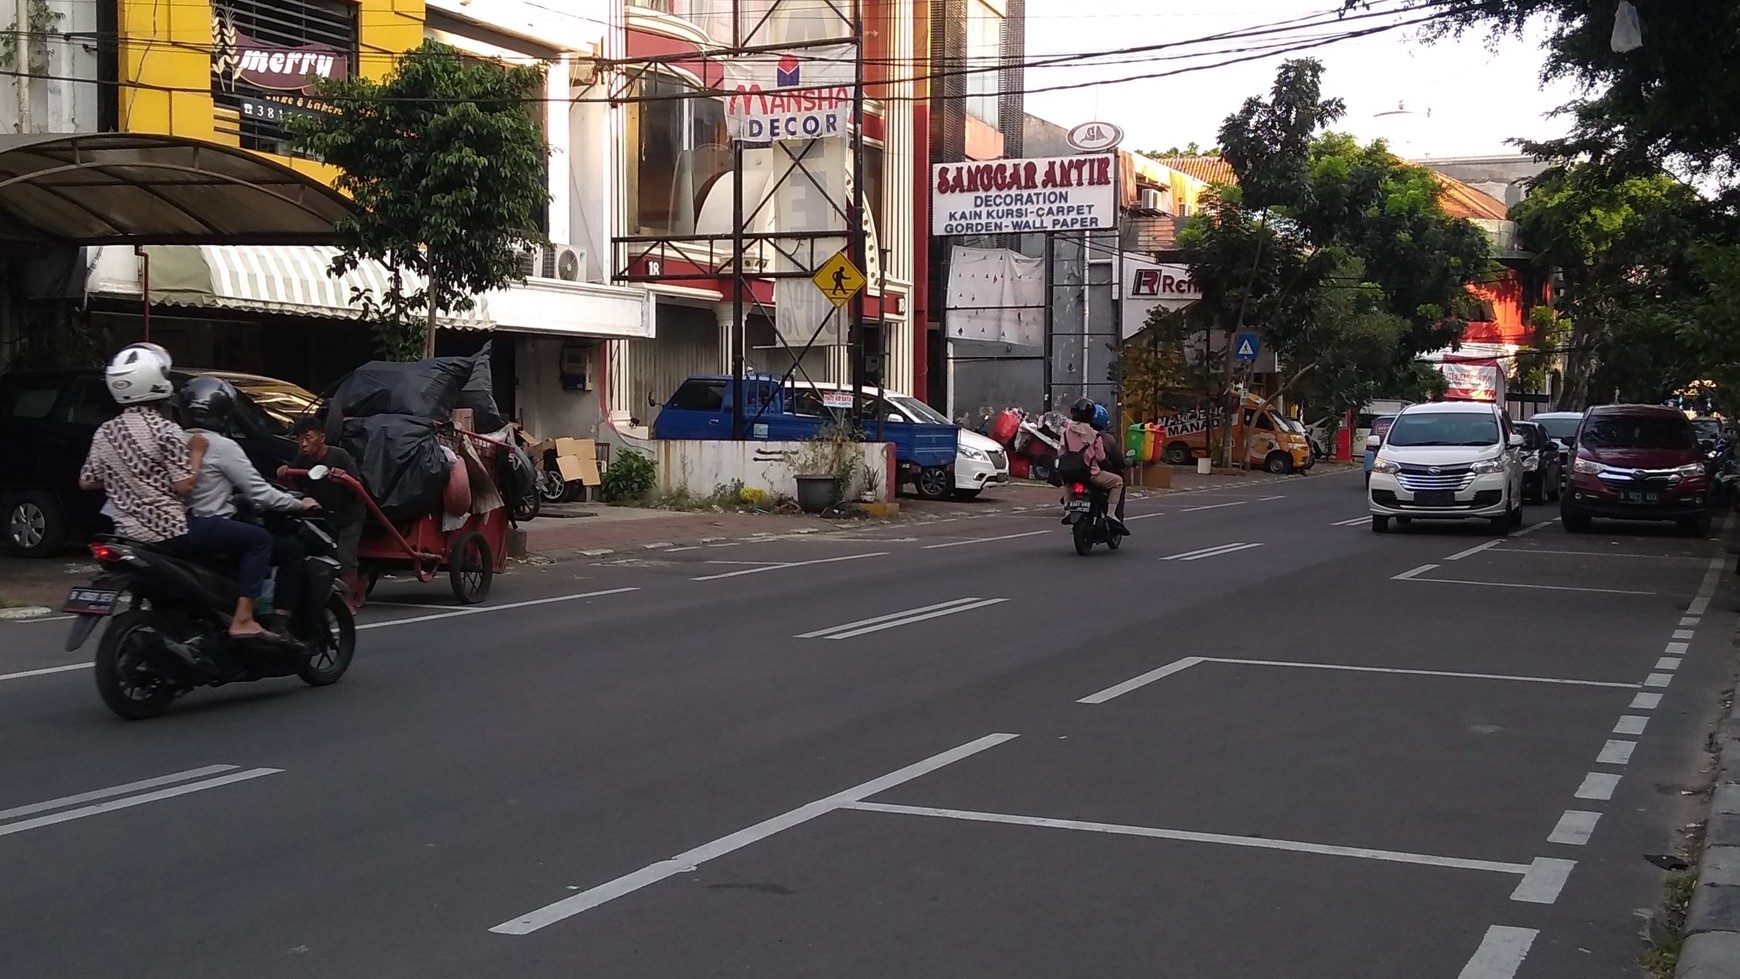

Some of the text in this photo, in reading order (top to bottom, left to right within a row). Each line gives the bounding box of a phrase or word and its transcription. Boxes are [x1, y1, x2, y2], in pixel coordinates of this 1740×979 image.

[238, 50, 334, 82] merry
[729, 84, 848, 116] MANSHA
[749, 114, 837, 138] DECOR
[937, 161, 1038, 194] SANGGAR
[974, 190, 1069, 208] DECORATION
[949, 209, 982, 221] KAIN
[1052, 217, 1099, 229] PAPER
[649, 261, 660, 276] 18
